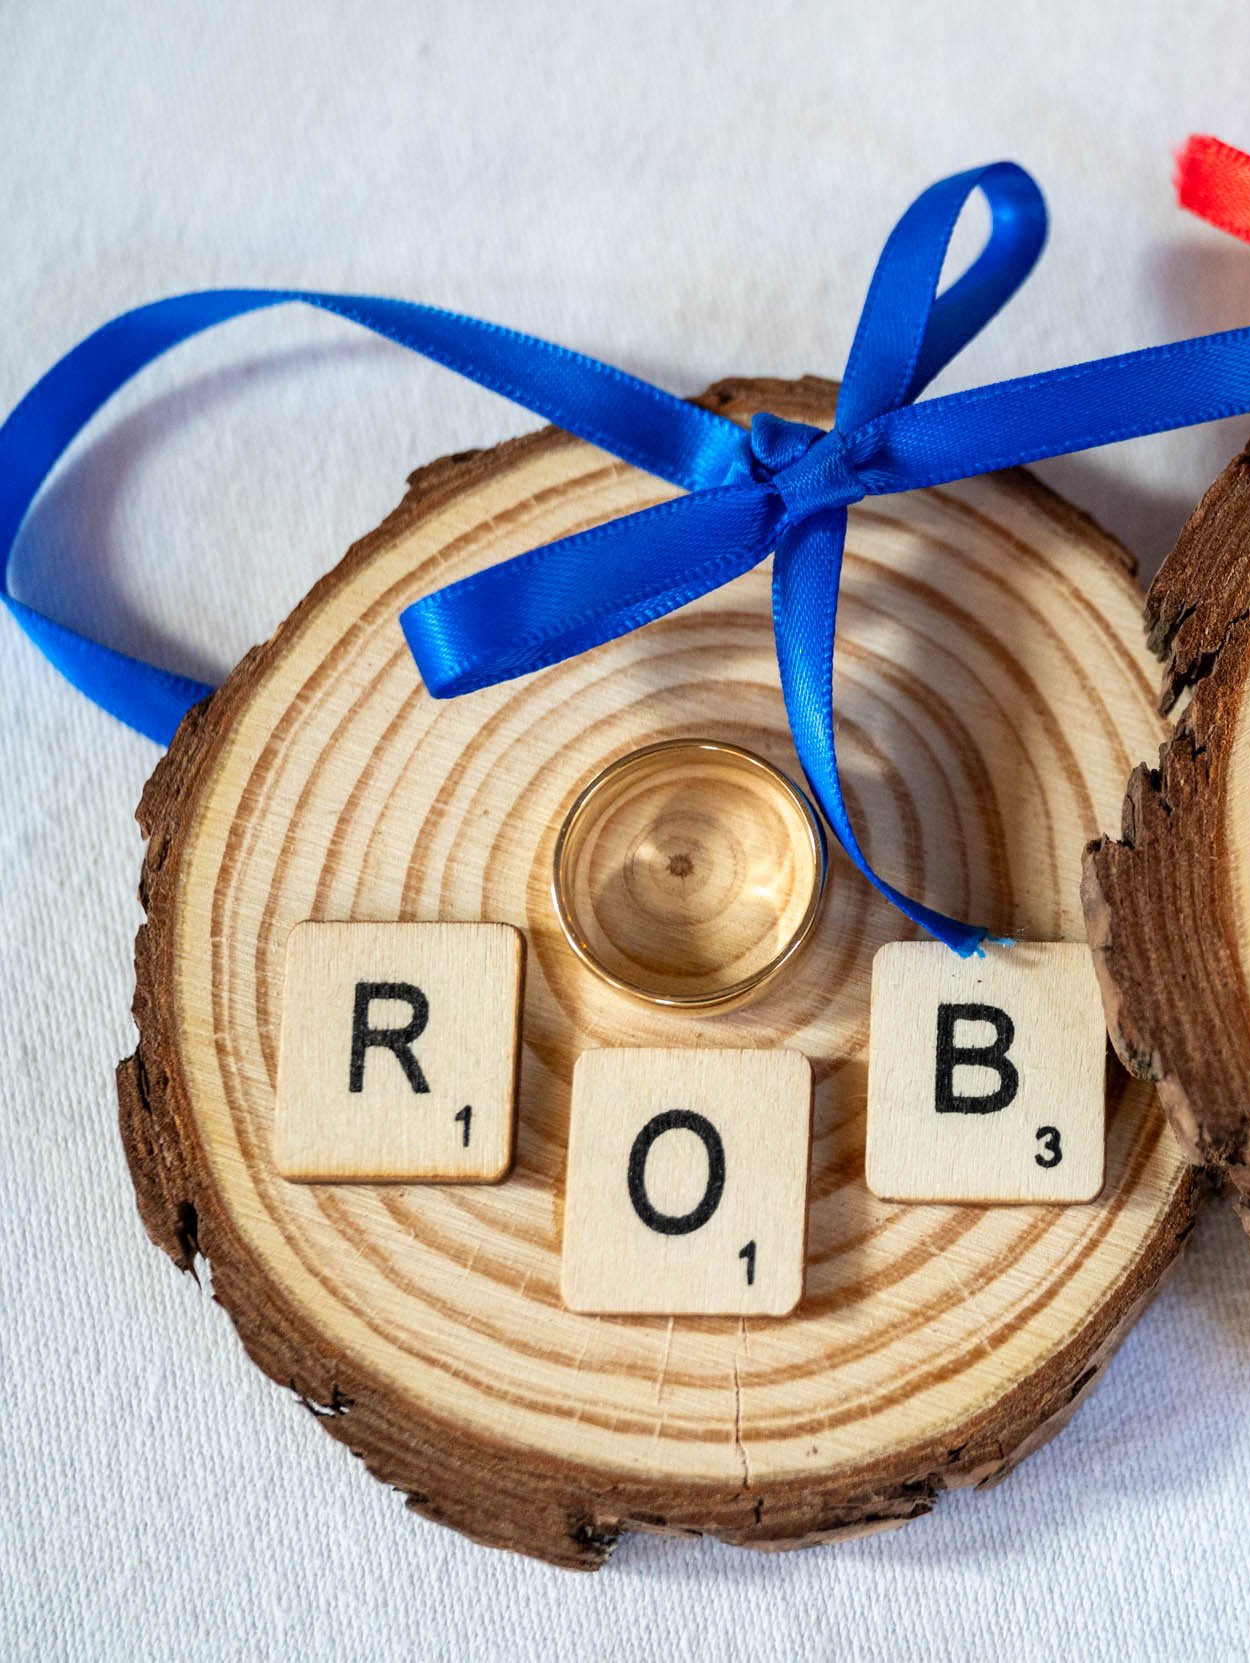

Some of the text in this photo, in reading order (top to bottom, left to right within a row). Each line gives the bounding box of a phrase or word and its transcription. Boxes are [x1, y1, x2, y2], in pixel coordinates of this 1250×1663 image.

[350, 982, 431, 1094] R
[934, 1002, 1019, 1115] B
[454, 1105, 472, 1148] 1
[1034, 1126, 1063, 1169] 3
[627, 1109, 726, 1236] O
[738, 1241, 756, 1286] 1
